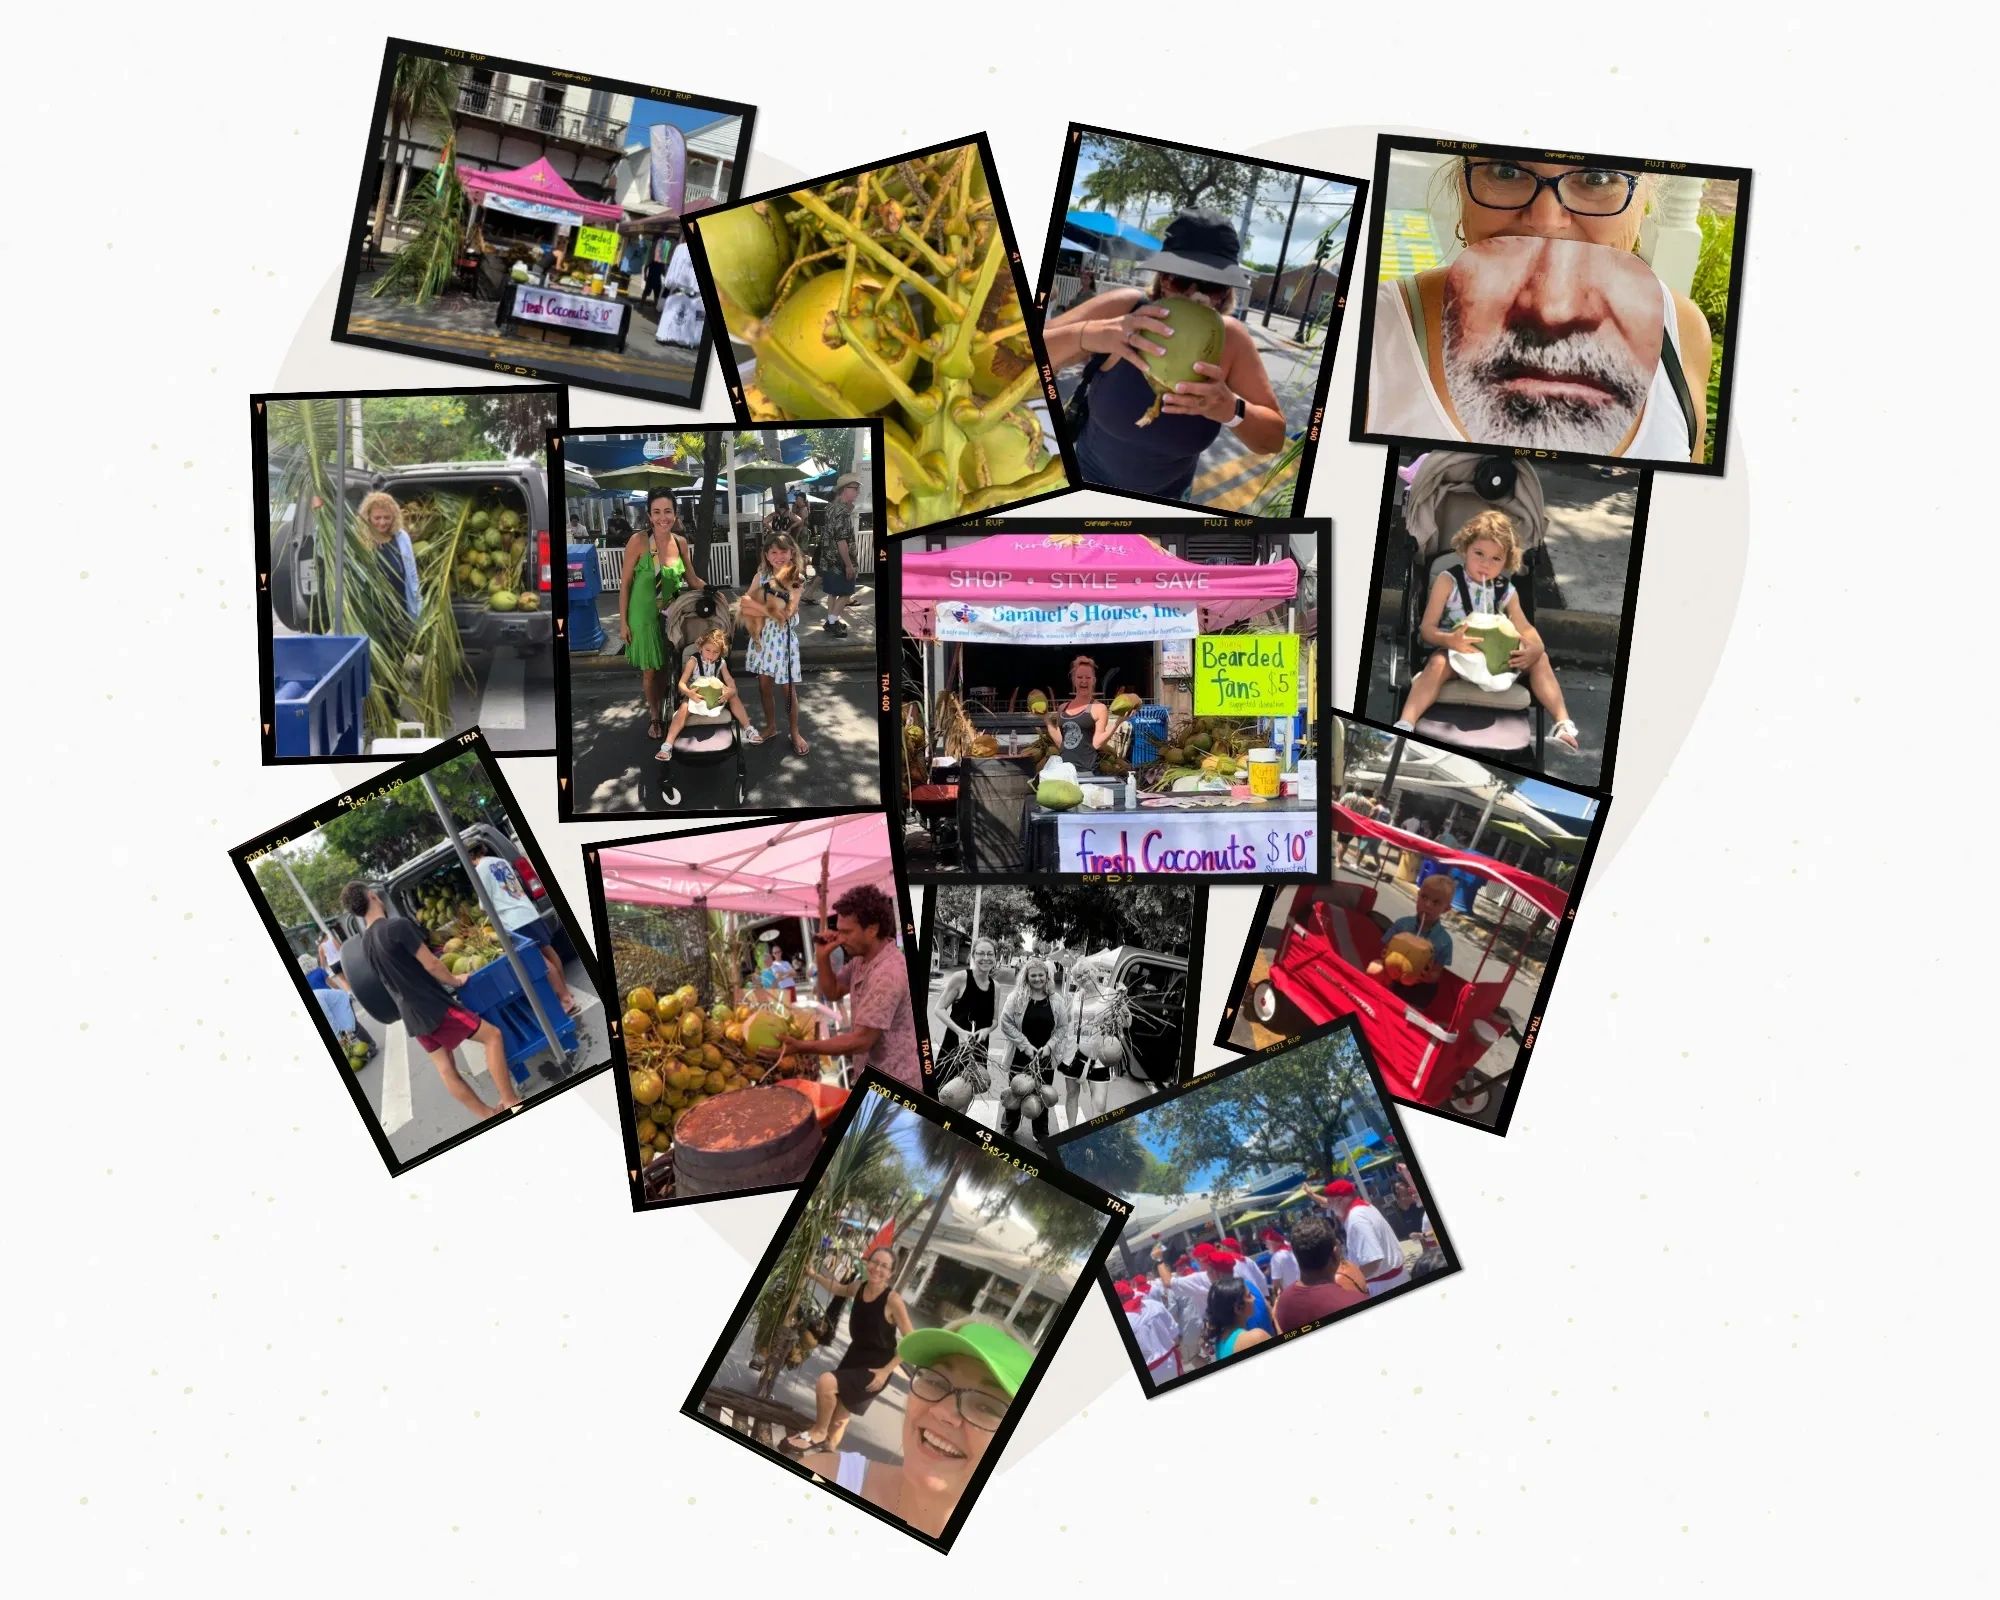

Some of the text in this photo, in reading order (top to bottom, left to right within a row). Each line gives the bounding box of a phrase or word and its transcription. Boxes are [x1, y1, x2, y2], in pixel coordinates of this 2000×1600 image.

[520, 292, 544, 315] fresh
[546, 298, 590, 321] Coconuts
[949, 570, 1210, 590] SHOP STYLE SAVE
[992, 603, 1187, 622] Samuel's House, Inc.
[1202, 640, 1284, 668] Bearded
[1211, 668, 1261, 706] fans
[1076, 828, 1136, 873] fresh
[1142, 829, 1257, 872] Coconuts
[1266, 828, 1306, 865] $10
